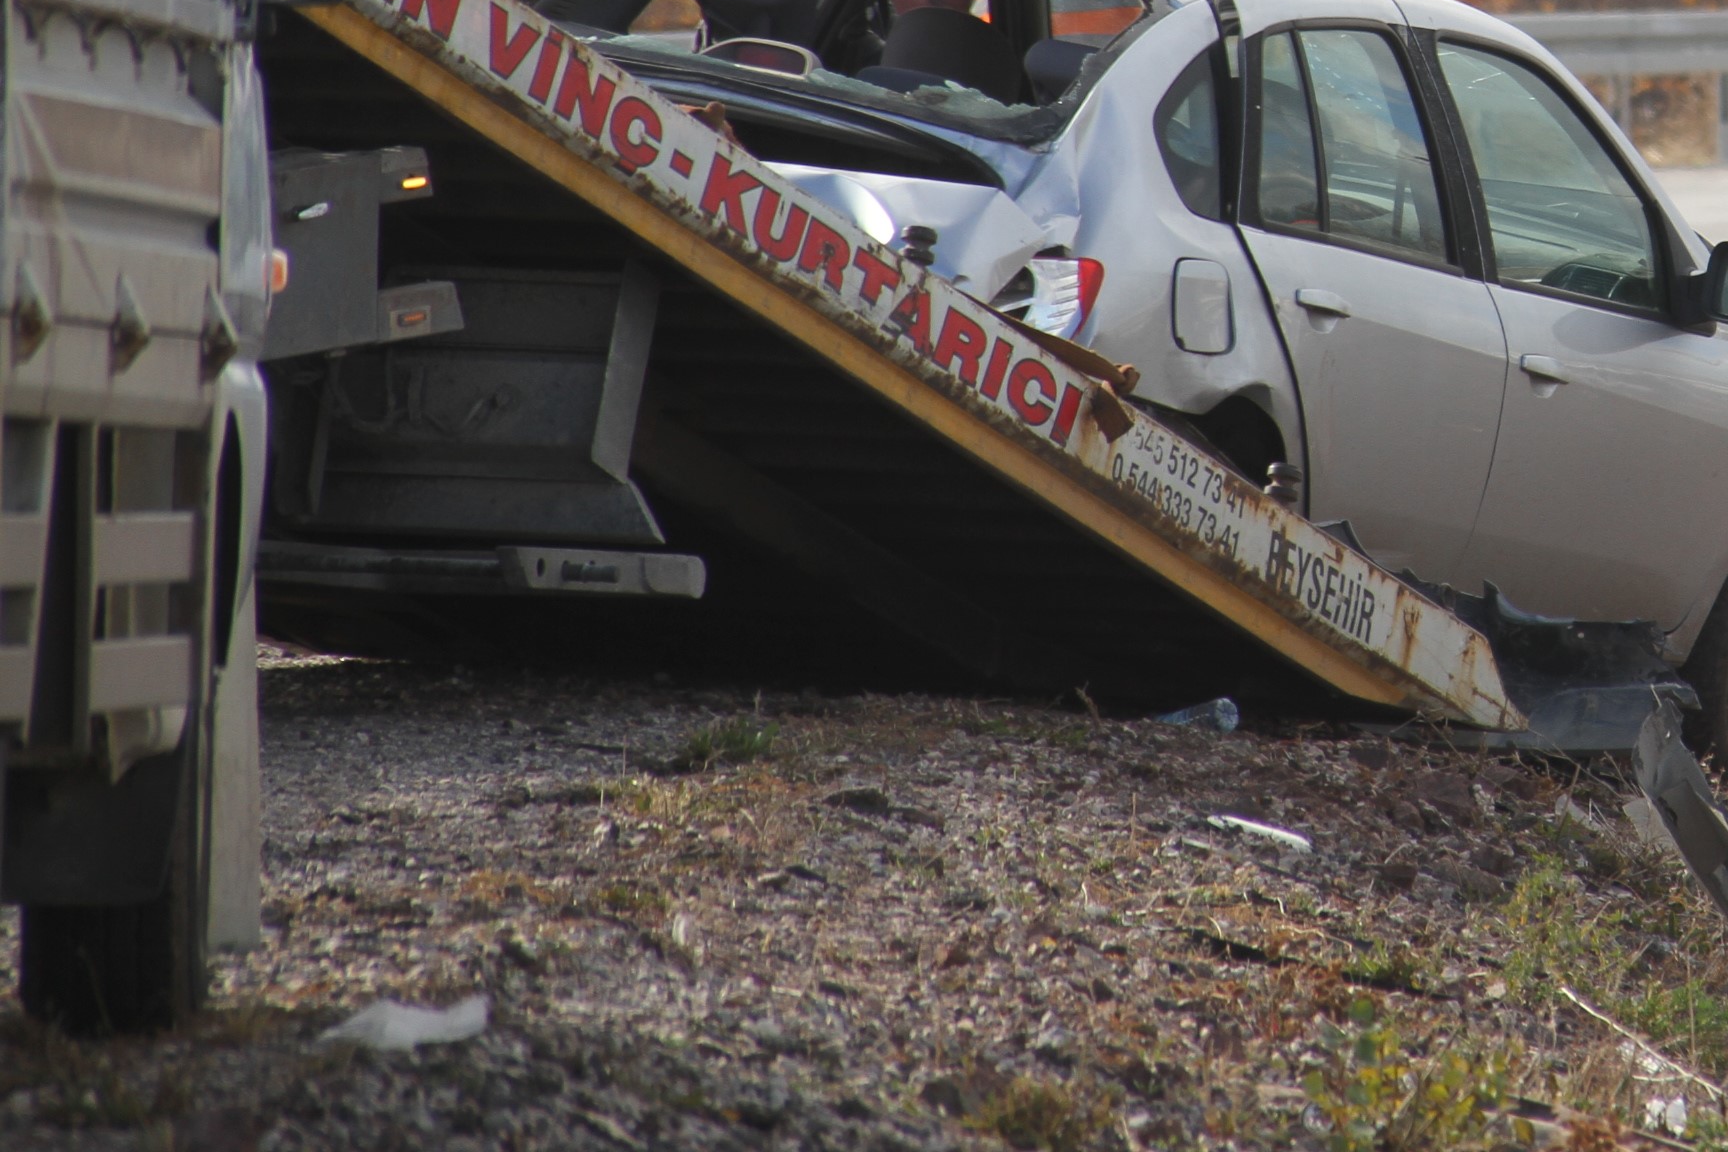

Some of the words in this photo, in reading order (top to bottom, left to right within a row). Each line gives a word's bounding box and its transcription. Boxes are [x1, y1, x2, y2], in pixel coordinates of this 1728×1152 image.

[1167, 445, 1199, 489] 512
[1203, 466, 1223, 504] 73
[1161, 485, 1192, 528] 333
[1197, 506, 1217, 544] 73
